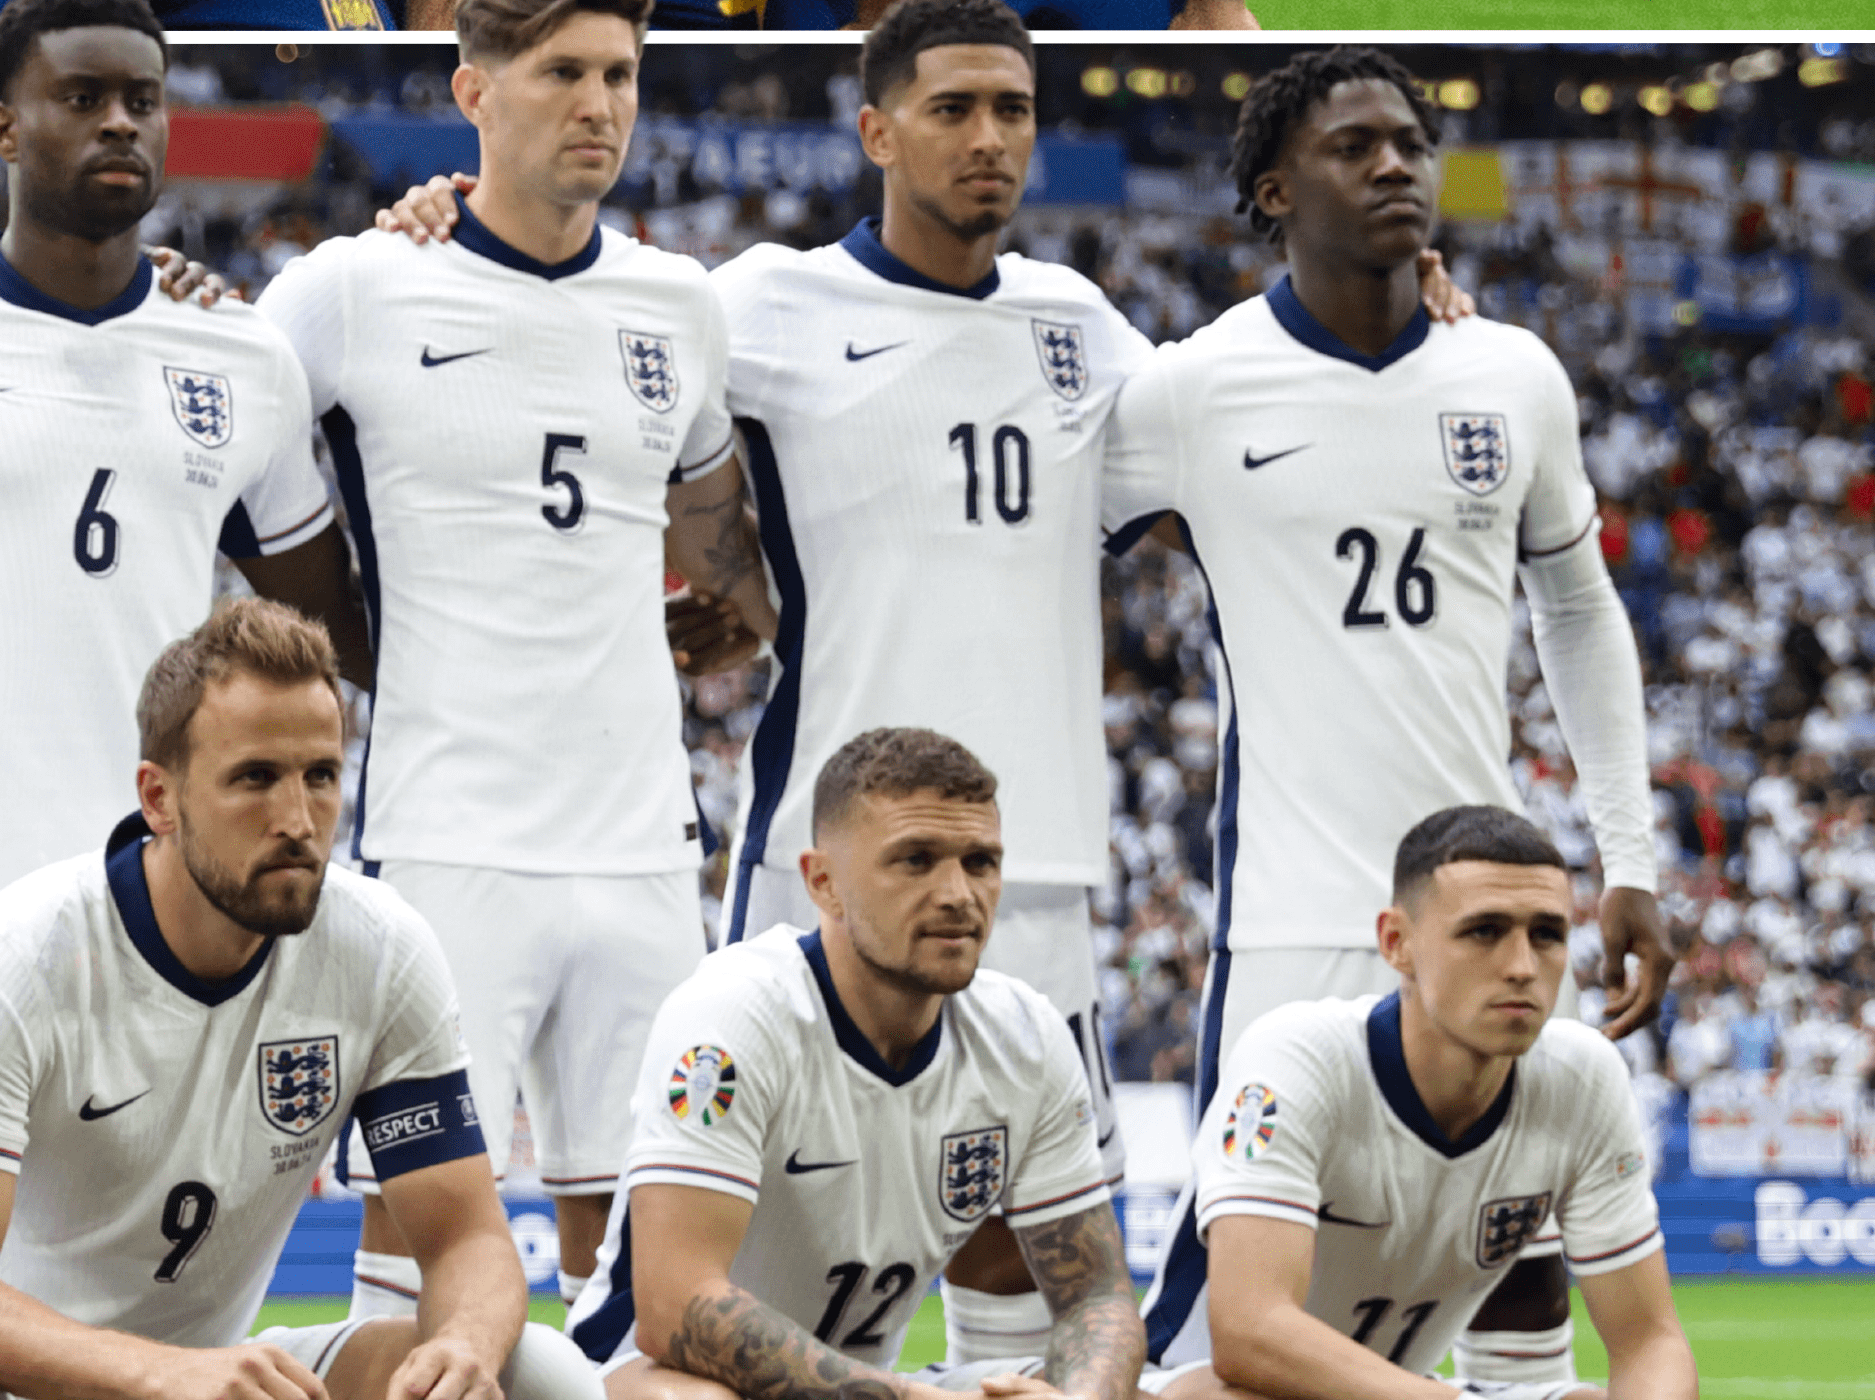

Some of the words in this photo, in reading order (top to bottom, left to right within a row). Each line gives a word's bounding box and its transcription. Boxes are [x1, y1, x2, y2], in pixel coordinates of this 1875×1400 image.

[73, 467, 122, 580] 6
[539, 432, 587, 539] 5
[948, 422, 1033, 526] 10
[1333, 527, 1438, 631] 26
[367, 1107, 441, 1148] RESPECT
[153, 1179, 219, 1284] 9
[815, 1260, 916, 1352] 12
[1351, 1294, 1442, 1366] 11
